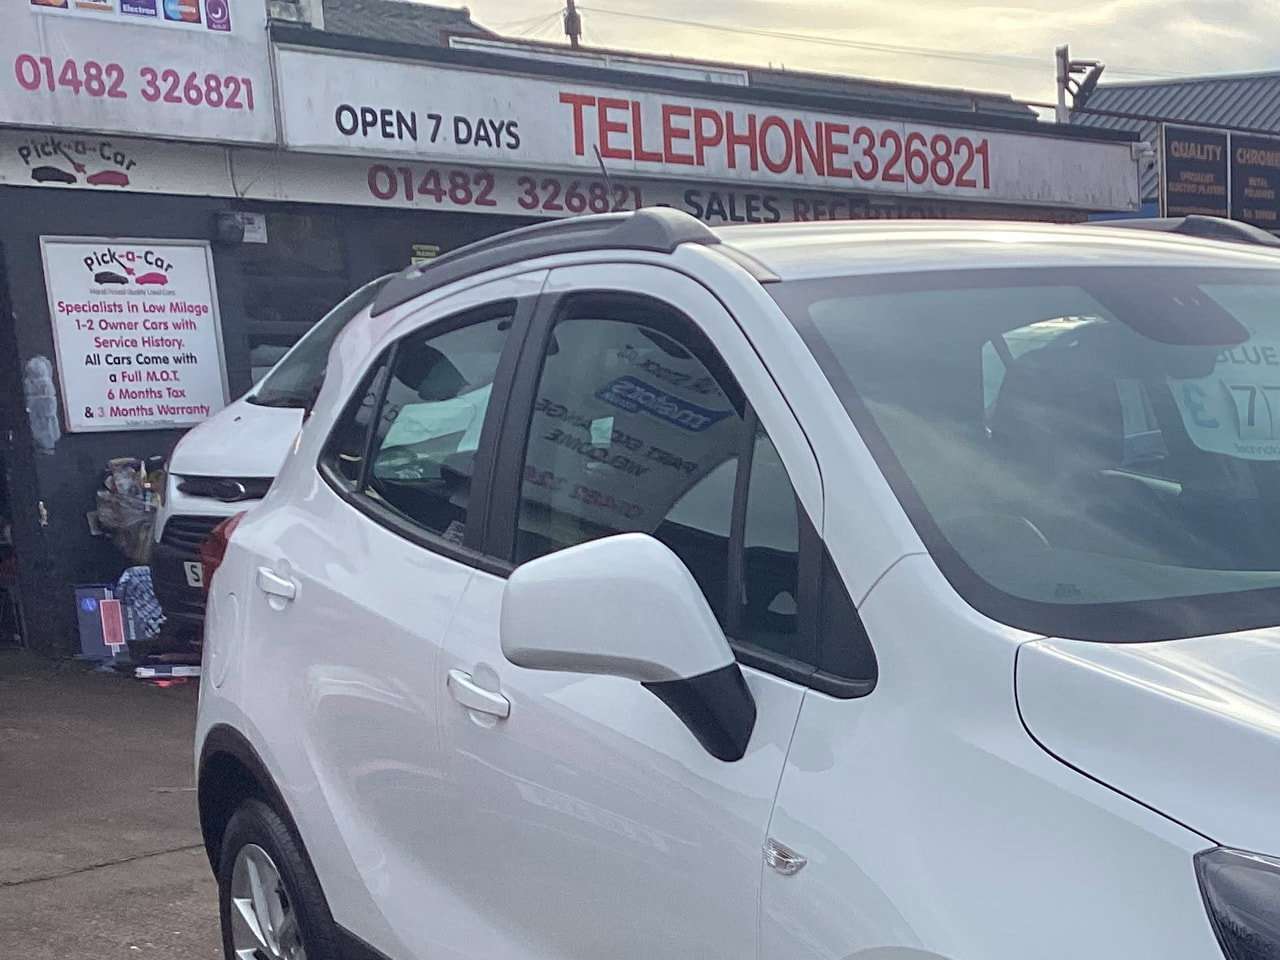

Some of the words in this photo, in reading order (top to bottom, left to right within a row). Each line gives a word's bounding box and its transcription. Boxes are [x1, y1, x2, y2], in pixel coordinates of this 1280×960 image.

[15, 54, 127, 98] 01482
[140, 67, 254, 111] 326821
[335, 104, 417, 141] OPEN
[427, 114, 442, 143] 7
[454, 116, 520, 150] DAYS
[1171, 141, 1222, 161] QUALITY
[367, 164, 497, 207] 01482
[517, 175, 642, 213] 326821
[684, 189, 781, 223] SALES
[58, 301, 123, 315] Specialists
[143, 301, 167, 313] Low
[170, 302, 209, 316] Milage
[75, 319, 94, 330] 1-2
[98, 319, 139, 330] Owner
[143, 319, 168, 330] Cars
[172, 318, 197, 330] with
[94, 336, 138, 348] Service
[85, 354, 101, 365] All
[105, 354, 132, 365] Cars
[136, 353, 170, 364] Come
[172, 353, 197, 364] with
[109, 374, 117, 383] a
[121, 371, 142, 382] Full
[107, 389, 115, 400] 6
[119, 388, 163, 400] Months
[166, 387, 186, 398] Tax
[84, 407, 94, 418] &
[110, 405, 154, 417] Months
[157, 404, 210, 418] Warranty
